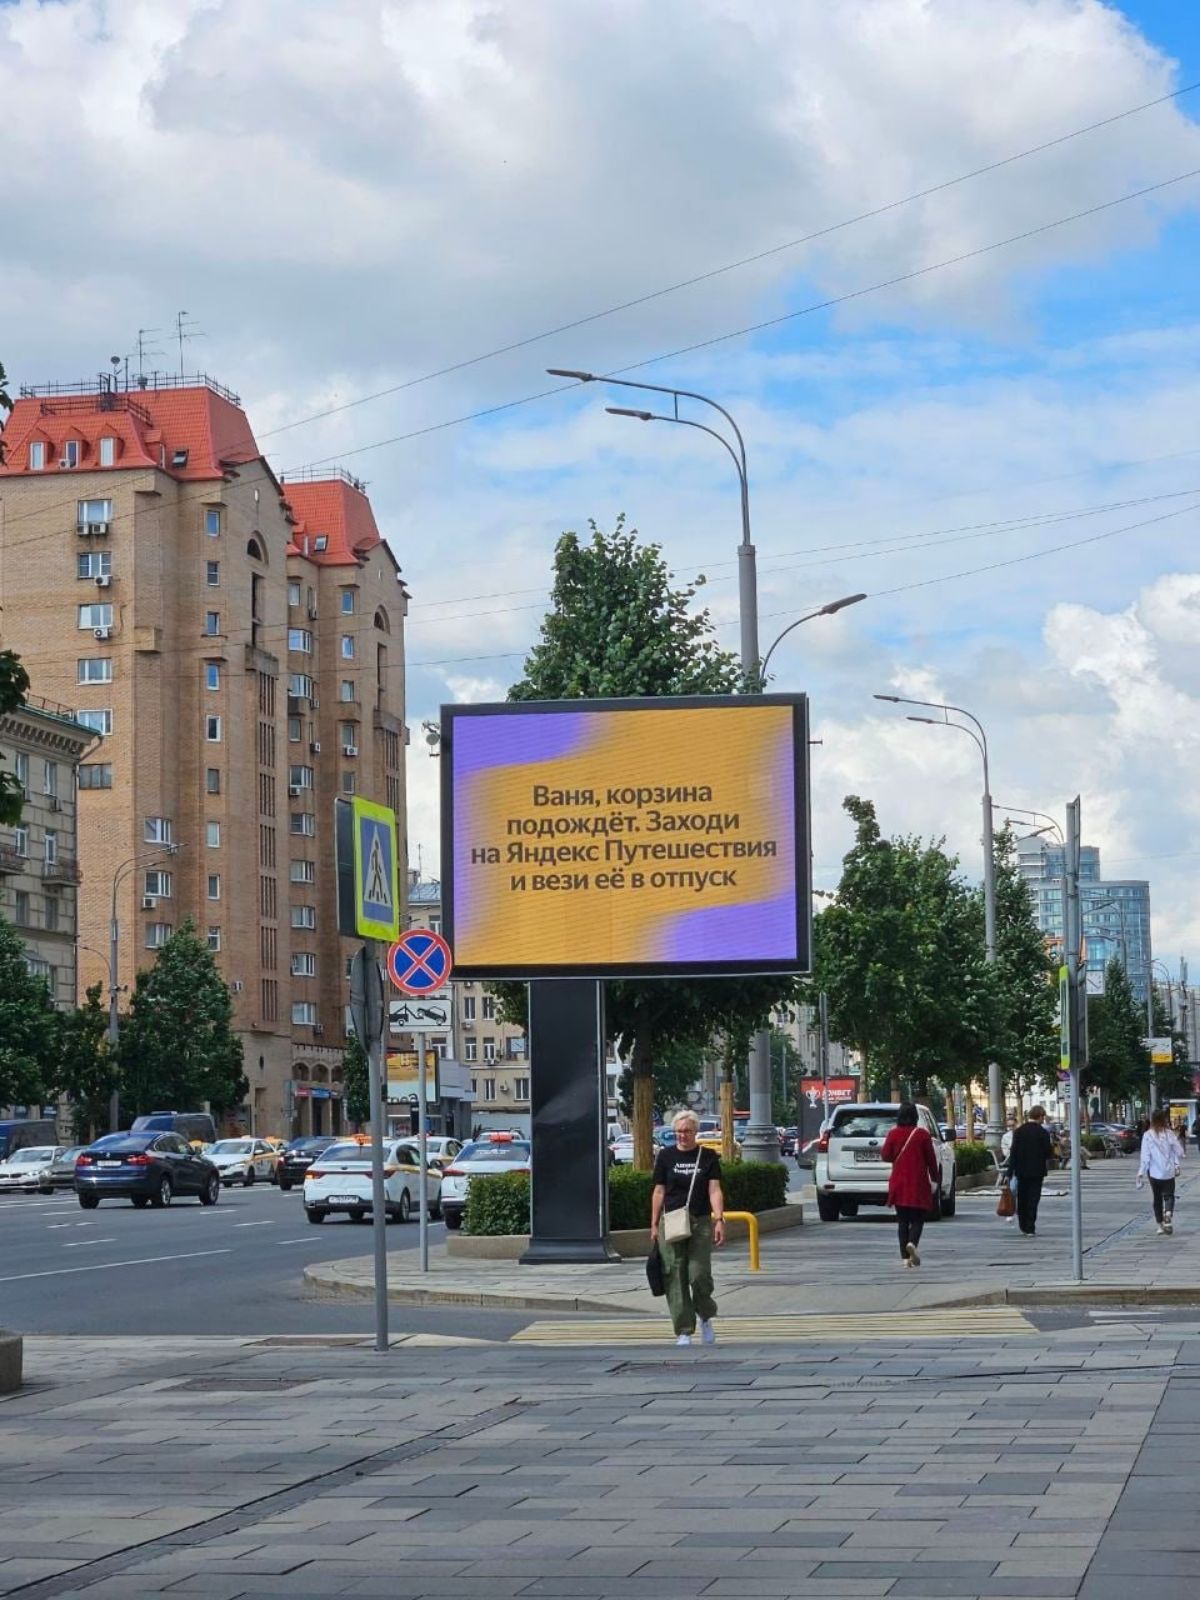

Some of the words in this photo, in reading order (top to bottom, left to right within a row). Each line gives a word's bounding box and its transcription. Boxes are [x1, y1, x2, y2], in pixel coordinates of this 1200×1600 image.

[533, 785, 600, 808] Ваня,
[606, 785, 712, 808] корзина
[506, 812, 641, 839] подождёт.
[645, 811, 740, 837] Заходи
[471, 847, 500, 864] на
[506, 842, 599, 866] Яндекс
[604, 839, 777, 866] Путешествия
[510, 875, 526, 891] и
[531, 873, 589, 891] вези
[594, 869, 625, 888] её
[631, 873, 645, 888] в
[650, 869, 737, 892] отпуск
